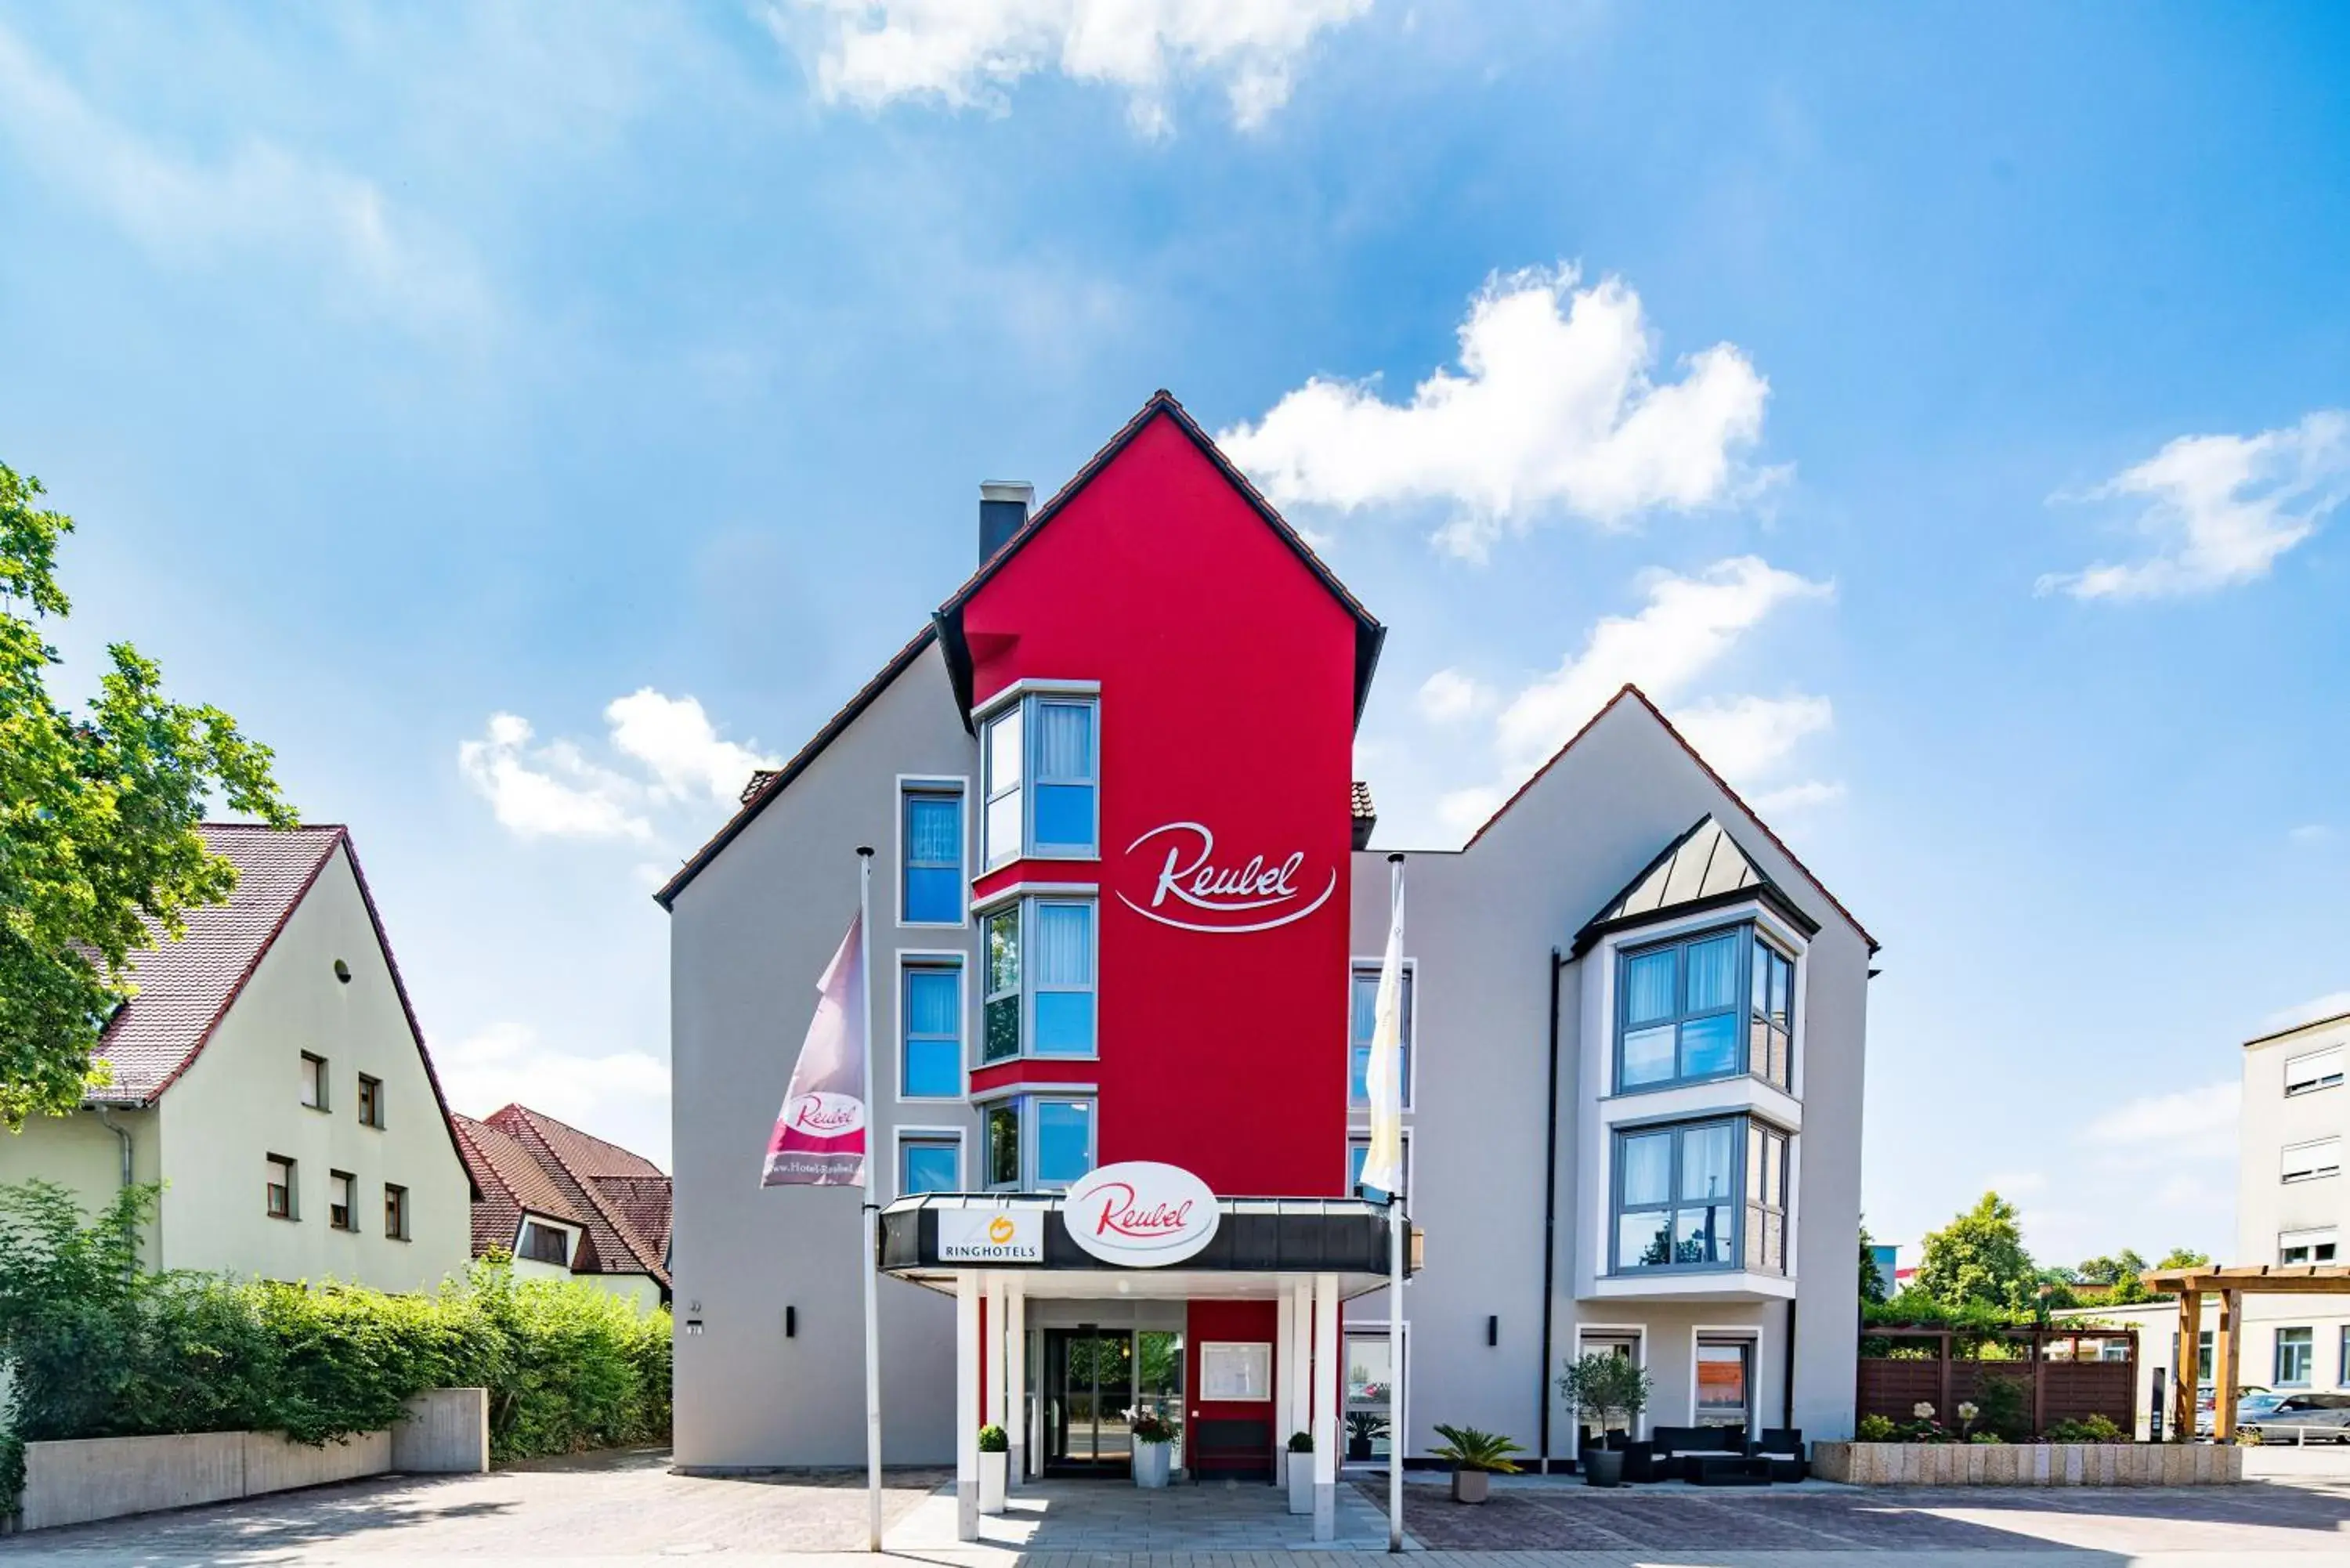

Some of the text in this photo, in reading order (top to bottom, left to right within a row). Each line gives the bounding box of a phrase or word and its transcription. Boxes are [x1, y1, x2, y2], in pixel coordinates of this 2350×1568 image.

[1125, 822, 1305, 911] Reubel
[1079, 1182, 1194, 1237] Reubel
[945, 1246, 1036, 1257] RINGHOTELS
